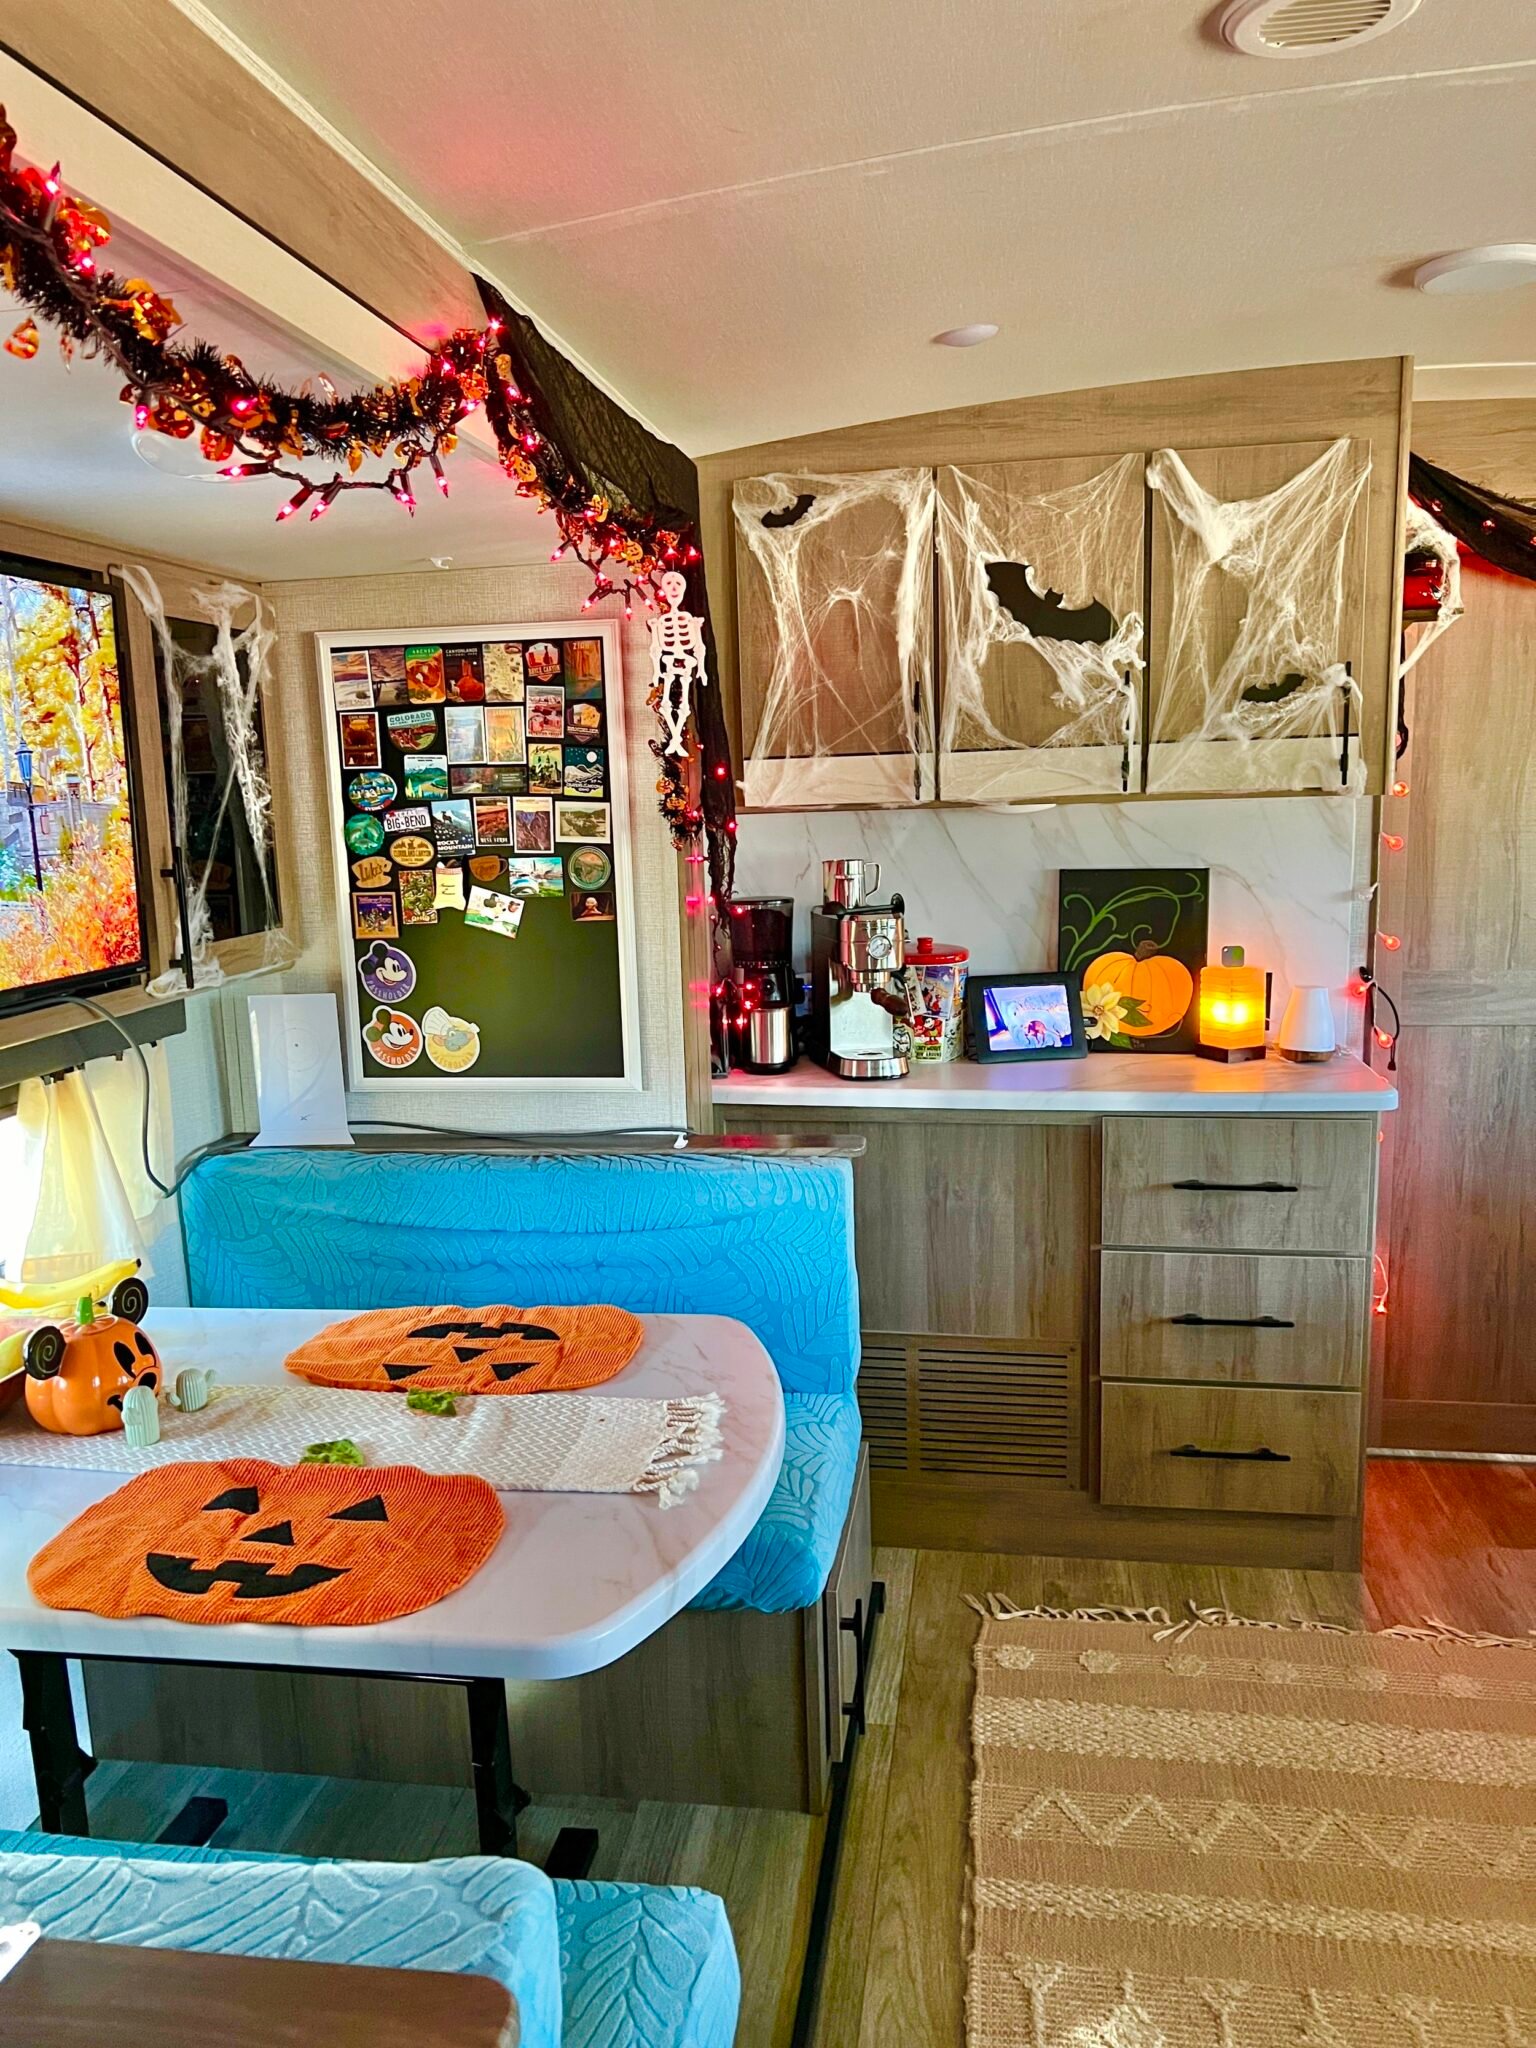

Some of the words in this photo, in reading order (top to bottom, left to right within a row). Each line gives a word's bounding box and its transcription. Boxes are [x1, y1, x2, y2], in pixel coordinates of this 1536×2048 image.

[573, 642, 590, 650] ZION
[389, 711, 432, 723] COLORADO
[386, 817, 401, 830] BIG
[404, 814, 427, 828] BEND
[436, 839, 459, 847] ROCKY
[437, 843, 473, 852] MOUNTAIN
[357, 861, 383, 883] Luke's
[366, 980, 410, 1000] PASSHOLDER
[374, 1046, 418, 1065] PASSHOLDER
